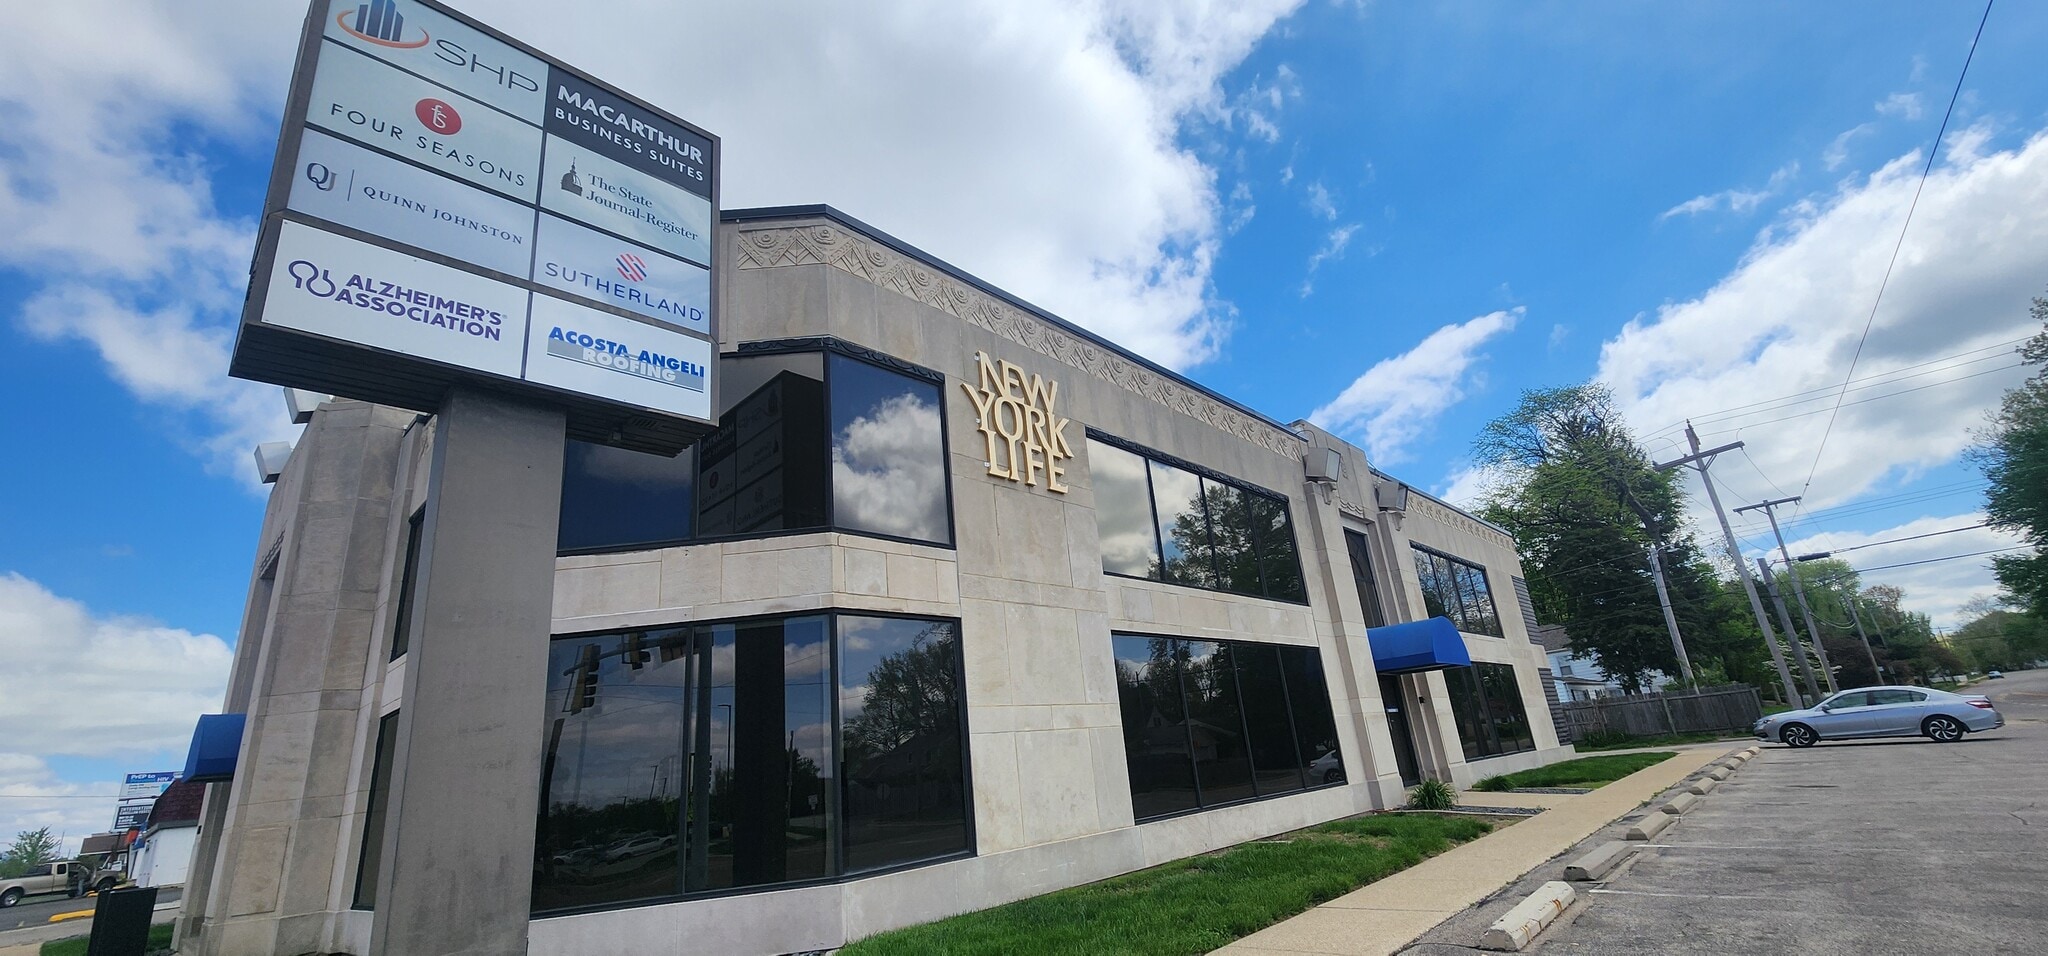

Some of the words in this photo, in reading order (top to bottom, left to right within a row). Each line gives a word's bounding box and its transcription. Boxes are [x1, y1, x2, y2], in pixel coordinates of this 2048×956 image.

[434, 39, 539, 92] SHP
[331, 103, 404, 141] FOUR
[416, 136, 525, 187] SEASONS
[555, 107, 642, 153] BUSINESS
[649, 149, 704, 182] SUITES
[557, 85, 704, 165] MACARTHUR
[363, 186, 427, 214] QUINN
[432, 208, 523, 245] JOHNSTON
[586, 190, 698, 241] Journal-Register
[588, 173, 616, 194] The
[618, 186, 653, 208] State
[335, 289, 501, 342] ASSOCIATION
[346, 274, 503, 326] ALZHEIMER'S
[545, 262, 703, 321] SUTHERLAND
[583, 348, 677, 382] ROOFING
[638, 350, 705, 378] ANGELI
[977, 350, 1058, 413] NEW
[960, 382, 1075, 460] YORK
[986, 431, 1069, 494] LIFE
